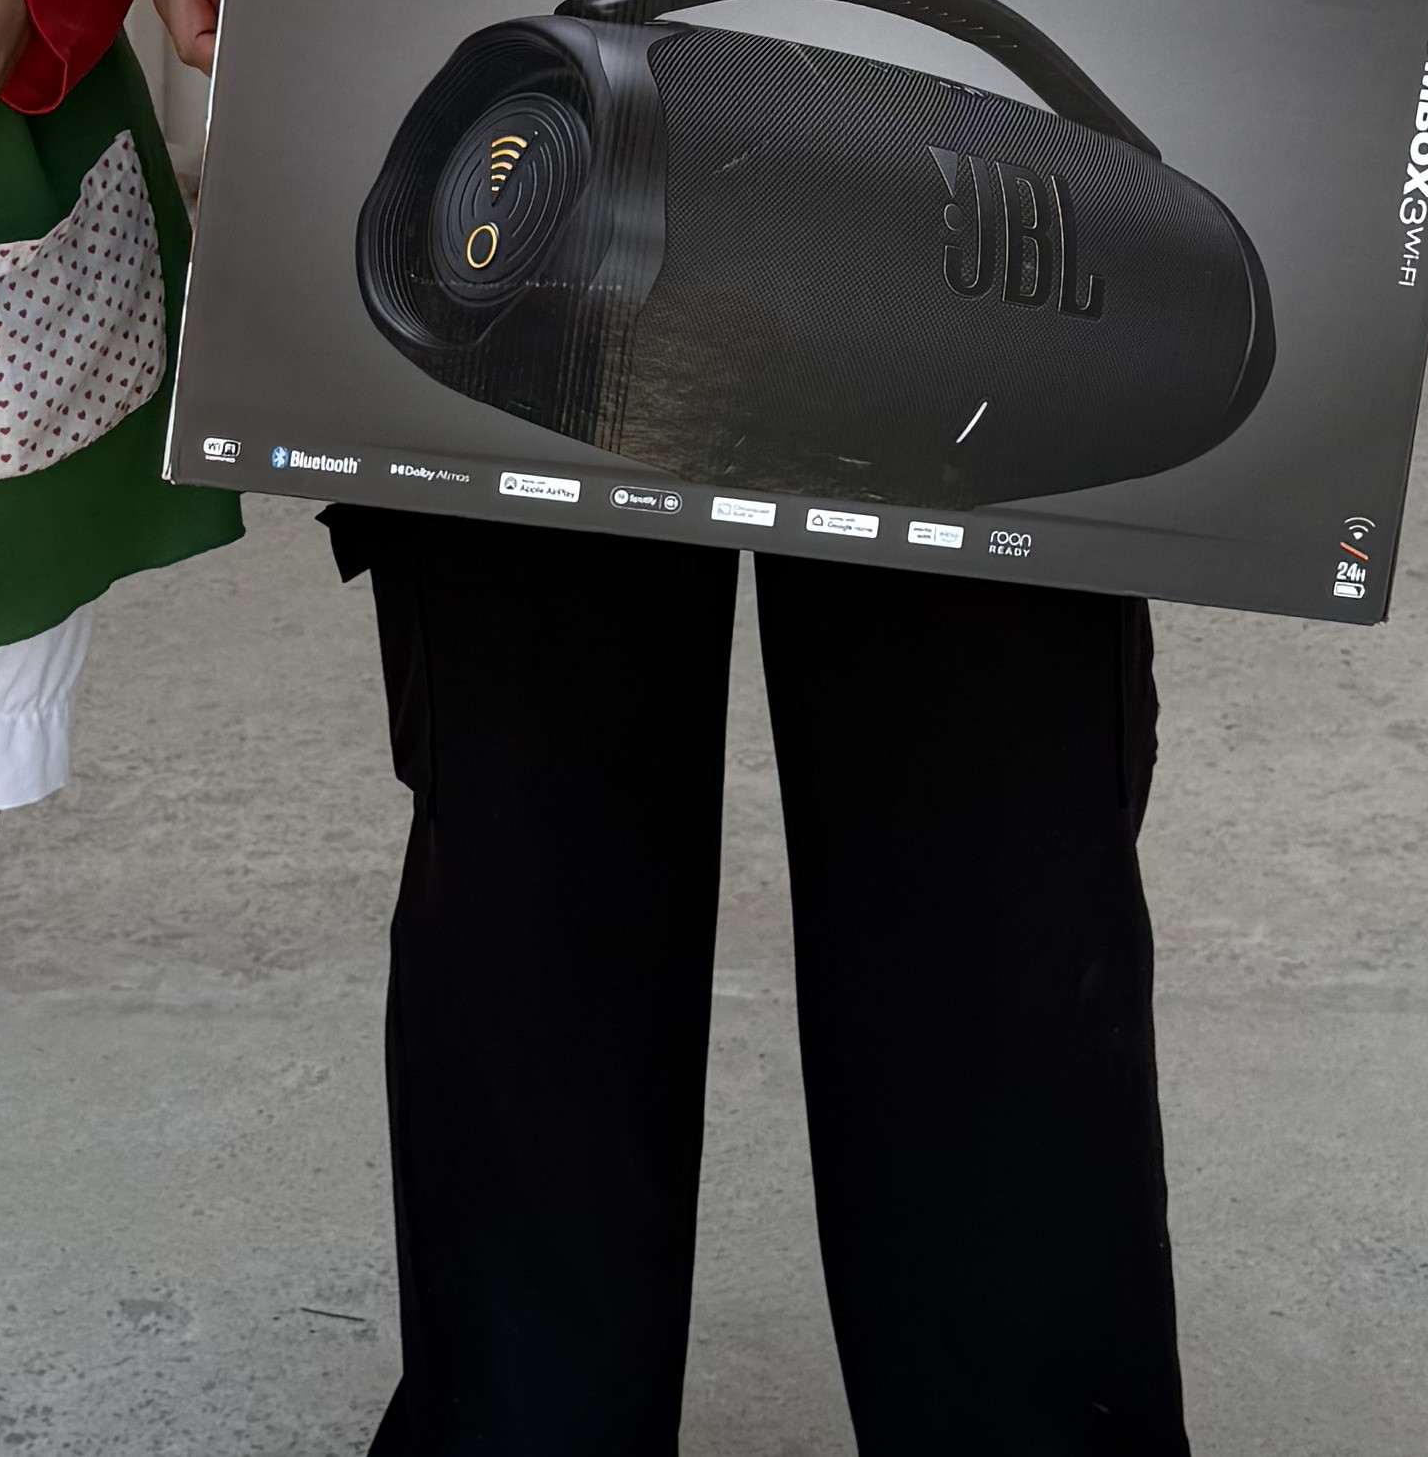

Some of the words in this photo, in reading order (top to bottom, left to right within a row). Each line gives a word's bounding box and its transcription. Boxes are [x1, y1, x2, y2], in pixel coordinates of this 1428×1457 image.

[926, 145, 1106, 323] JBL
[289, 450, 358, 474] Bluetooth
[404, 465, 435, 481] Dolby
[989, 530, 1032, 547] roon
[988, 546, 1031, 557] READY
[1336, 561, 1366, 582] 24H
